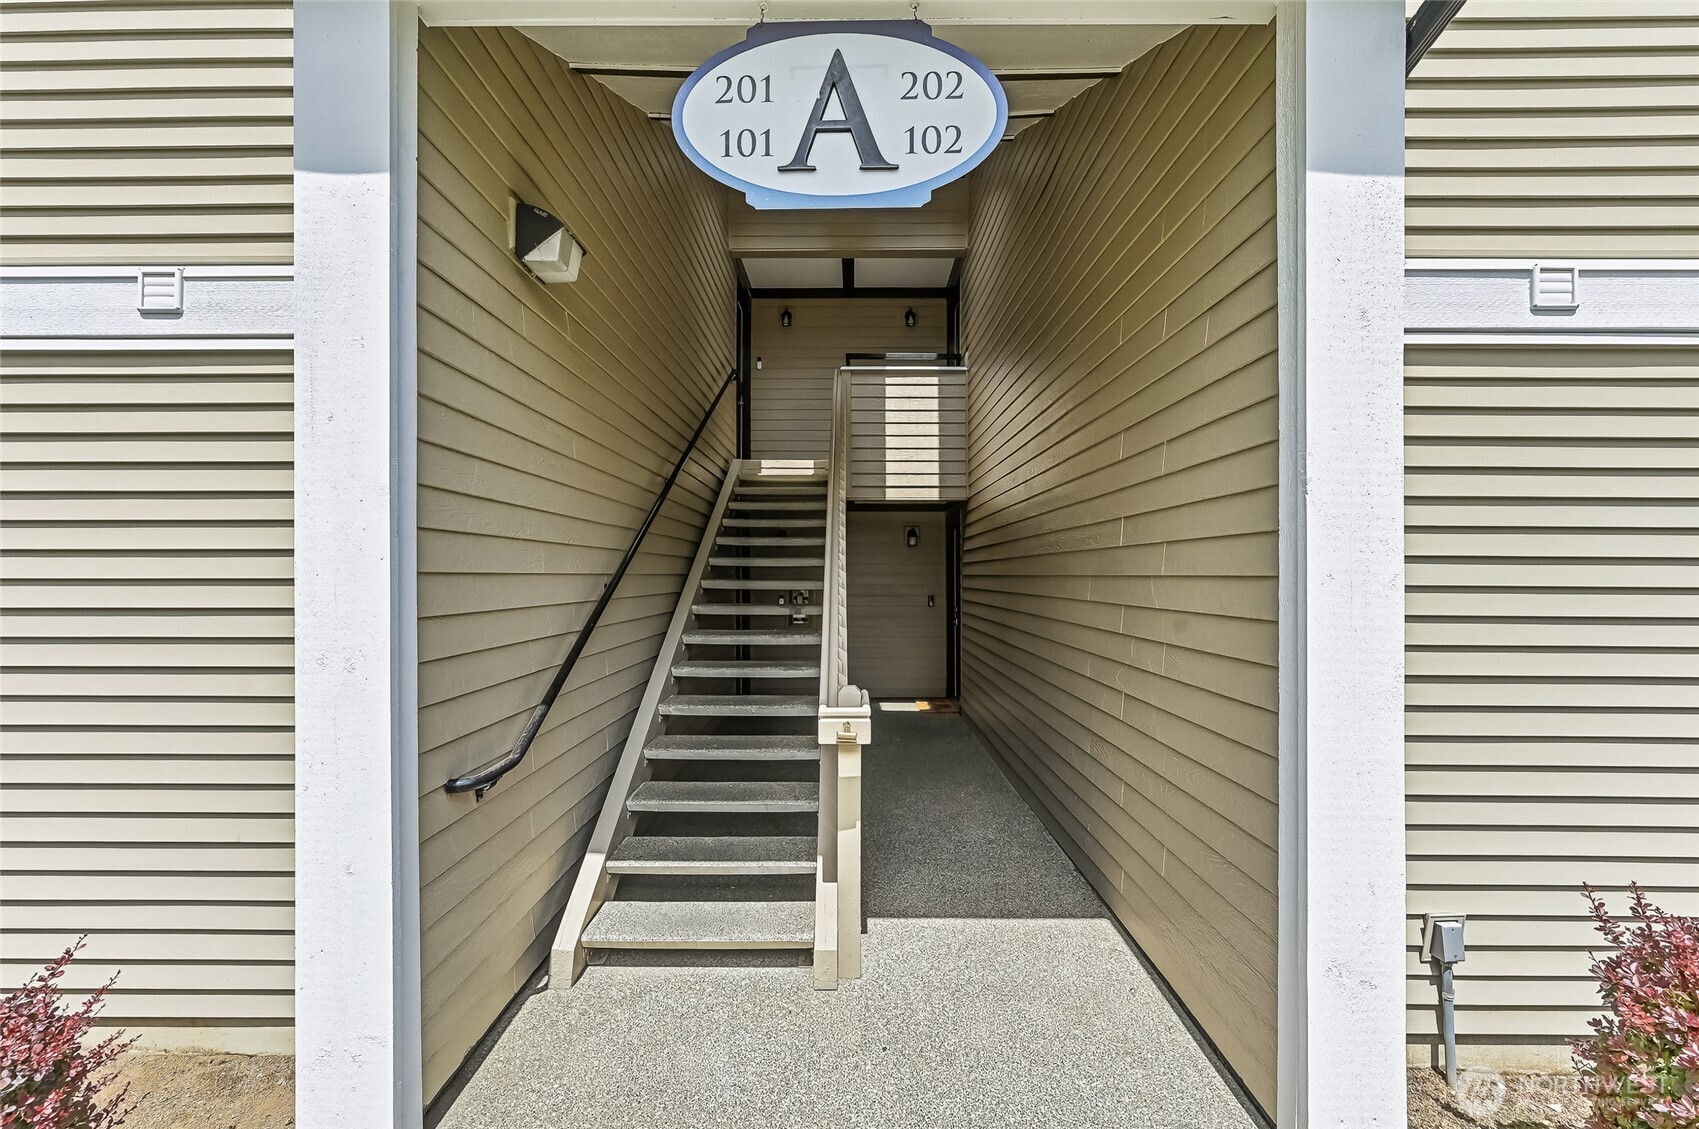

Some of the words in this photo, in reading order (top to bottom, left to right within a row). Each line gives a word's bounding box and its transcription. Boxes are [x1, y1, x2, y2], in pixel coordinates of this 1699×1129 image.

[714, 74, 774, 104] 201
[900, 71, 964, 101] 202
[777, 48, 899, 171] A
[719, 128, 774, 157] 101
[904, 125, 963, 155] 102
